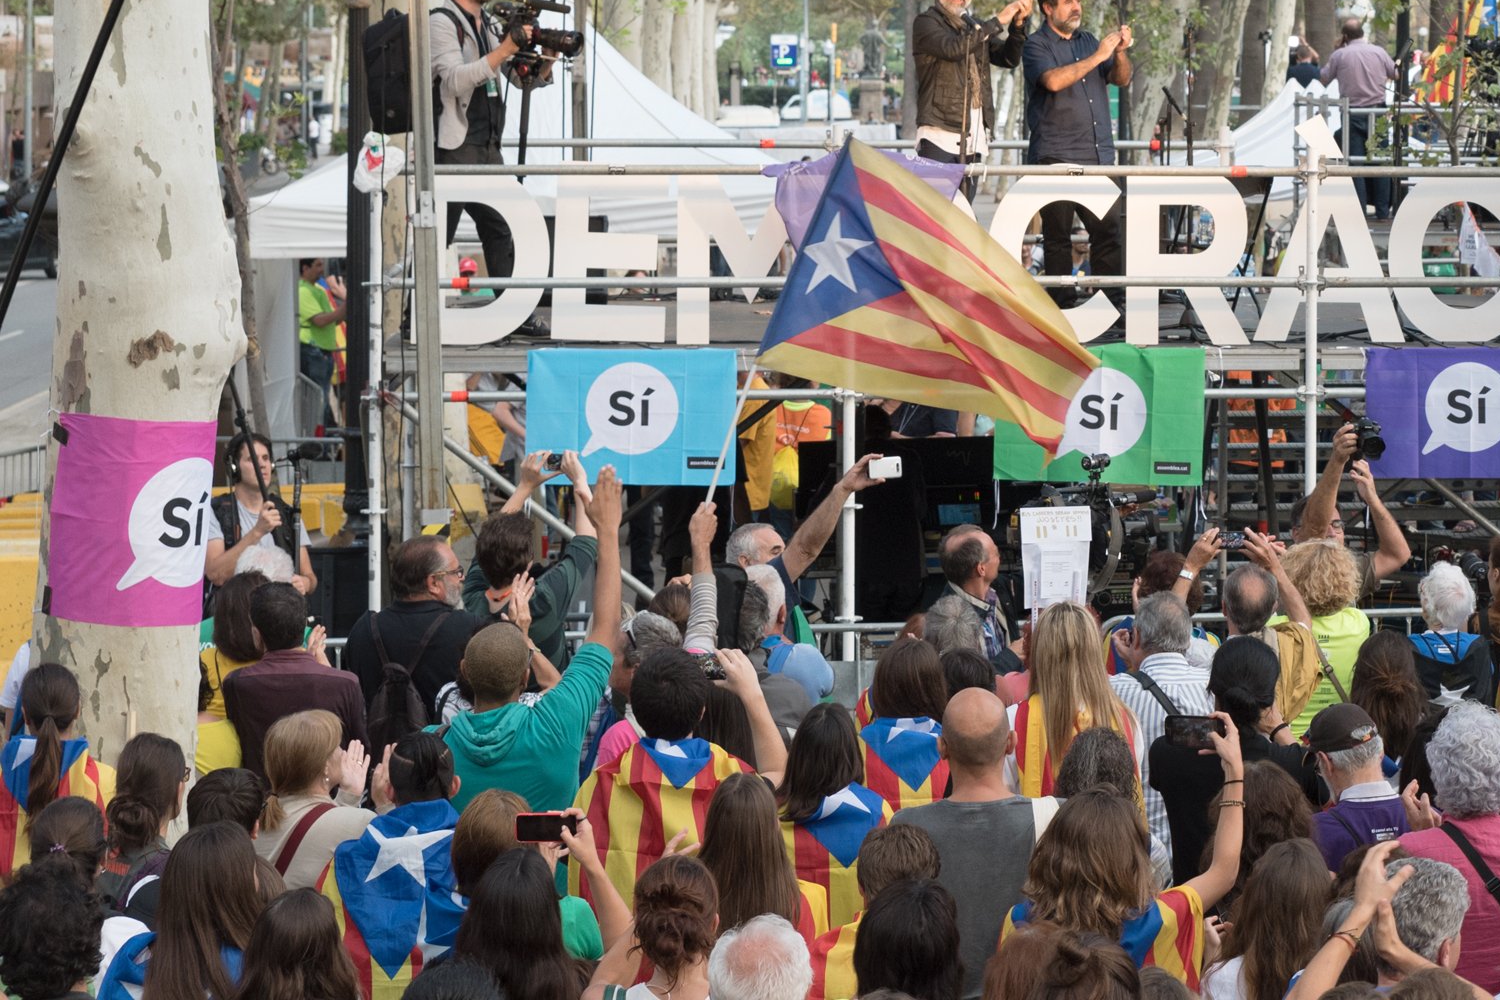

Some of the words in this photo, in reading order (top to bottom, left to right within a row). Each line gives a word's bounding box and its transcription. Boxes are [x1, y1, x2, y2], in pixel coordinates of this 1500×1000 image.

[608, 387, 655, 426] Sí
[1079, 392, 1123, 430] Sí
[1446, 386, 1491, 424] Sí
[158, 490, 209, 548] Sí
